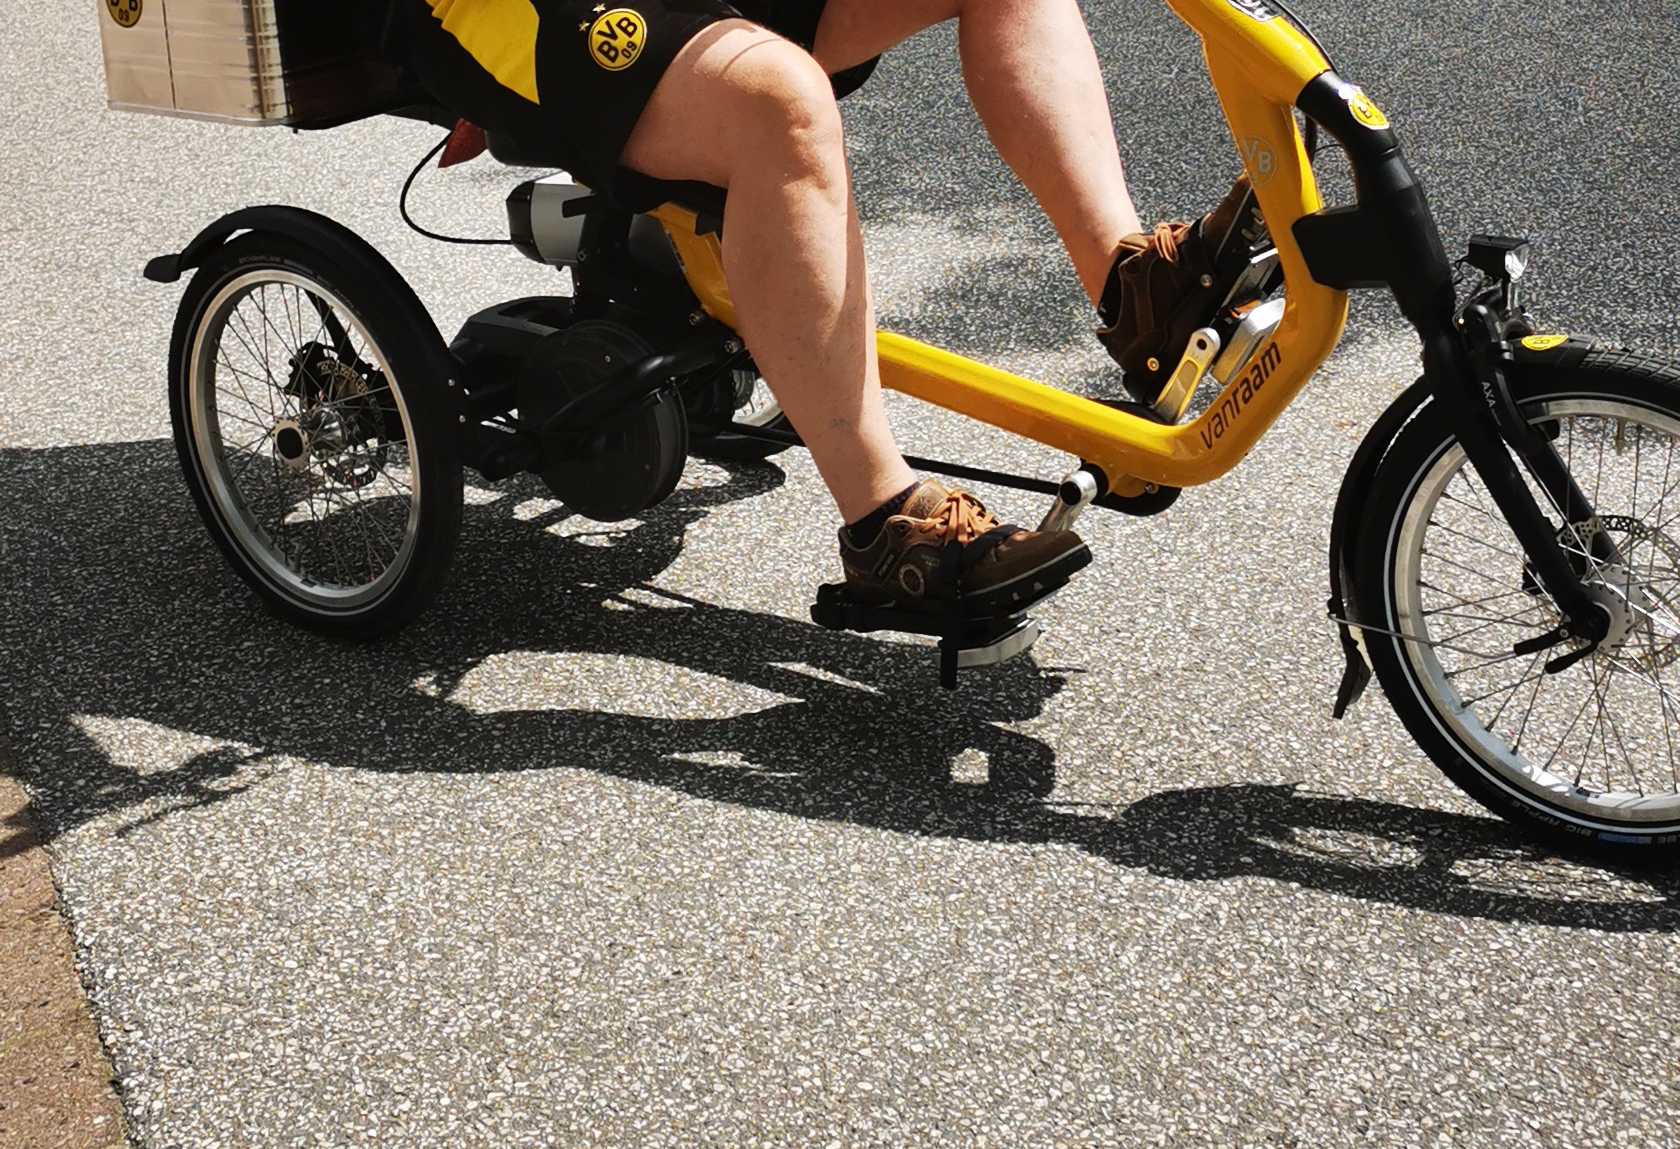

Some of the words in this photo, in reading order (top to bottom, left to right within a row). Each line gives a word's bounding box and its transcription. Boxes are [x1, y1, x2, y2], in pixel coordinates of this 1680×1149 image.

[596, 16, 638, 64] BVB
[621, 40, 637, 59] 09
[1200, 341, 1282, 450] vanraam
[1481, 381, 1497, 408] AXA
